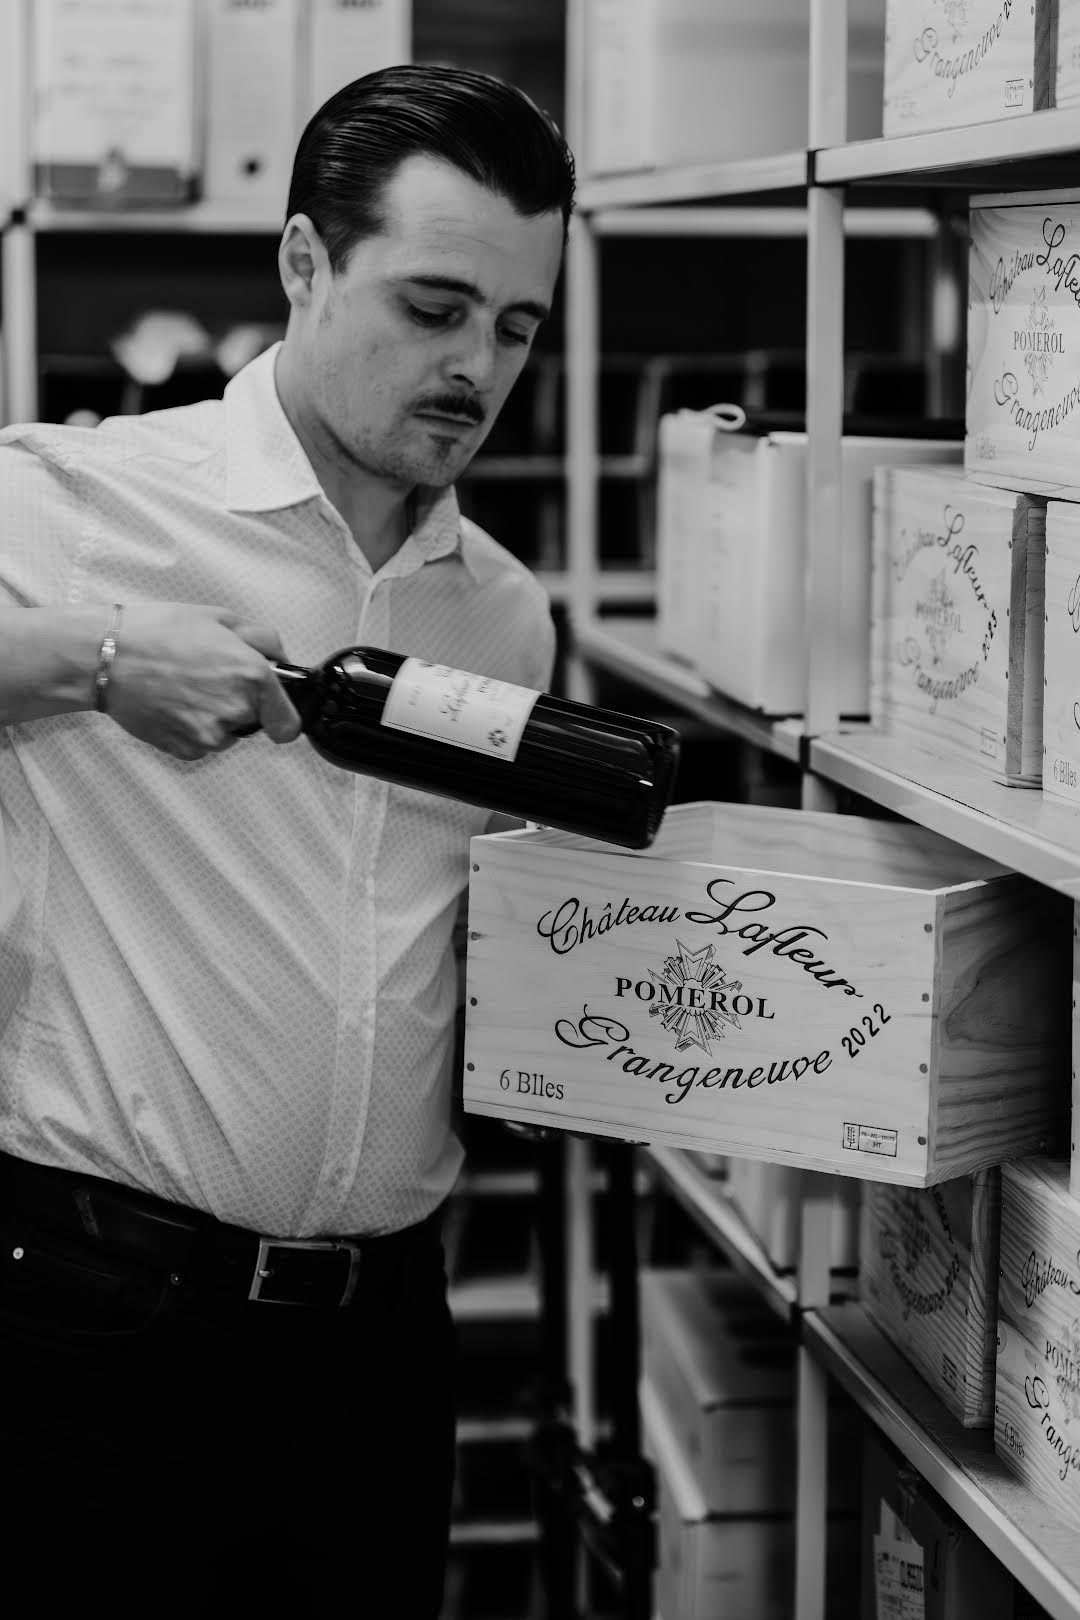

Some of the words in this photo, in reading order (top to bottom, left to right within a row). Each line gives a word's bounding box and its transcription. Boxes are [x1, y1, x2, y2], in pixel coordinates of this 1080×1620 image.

[989, 249, 1034, 315] Château
[1013, 330, 1065, 354] POMEROL
[1053, 759, 1058, 782] 6
[1059, 760, 1077, 788] Blles
[536, 896, 681, 955] Château
[684, 878, 864, 999] Lafleur
[614, 976, 777, 1021] POMEROL
[554, 1003, 833, 1105] Grangeneuve
[841, 1003, 892, 1058] 2022
[499, 1069, 512, 1092] 6
[515, 1070, 565, 1100] Blles
[1021, 1251, 1069, 1308] Château
